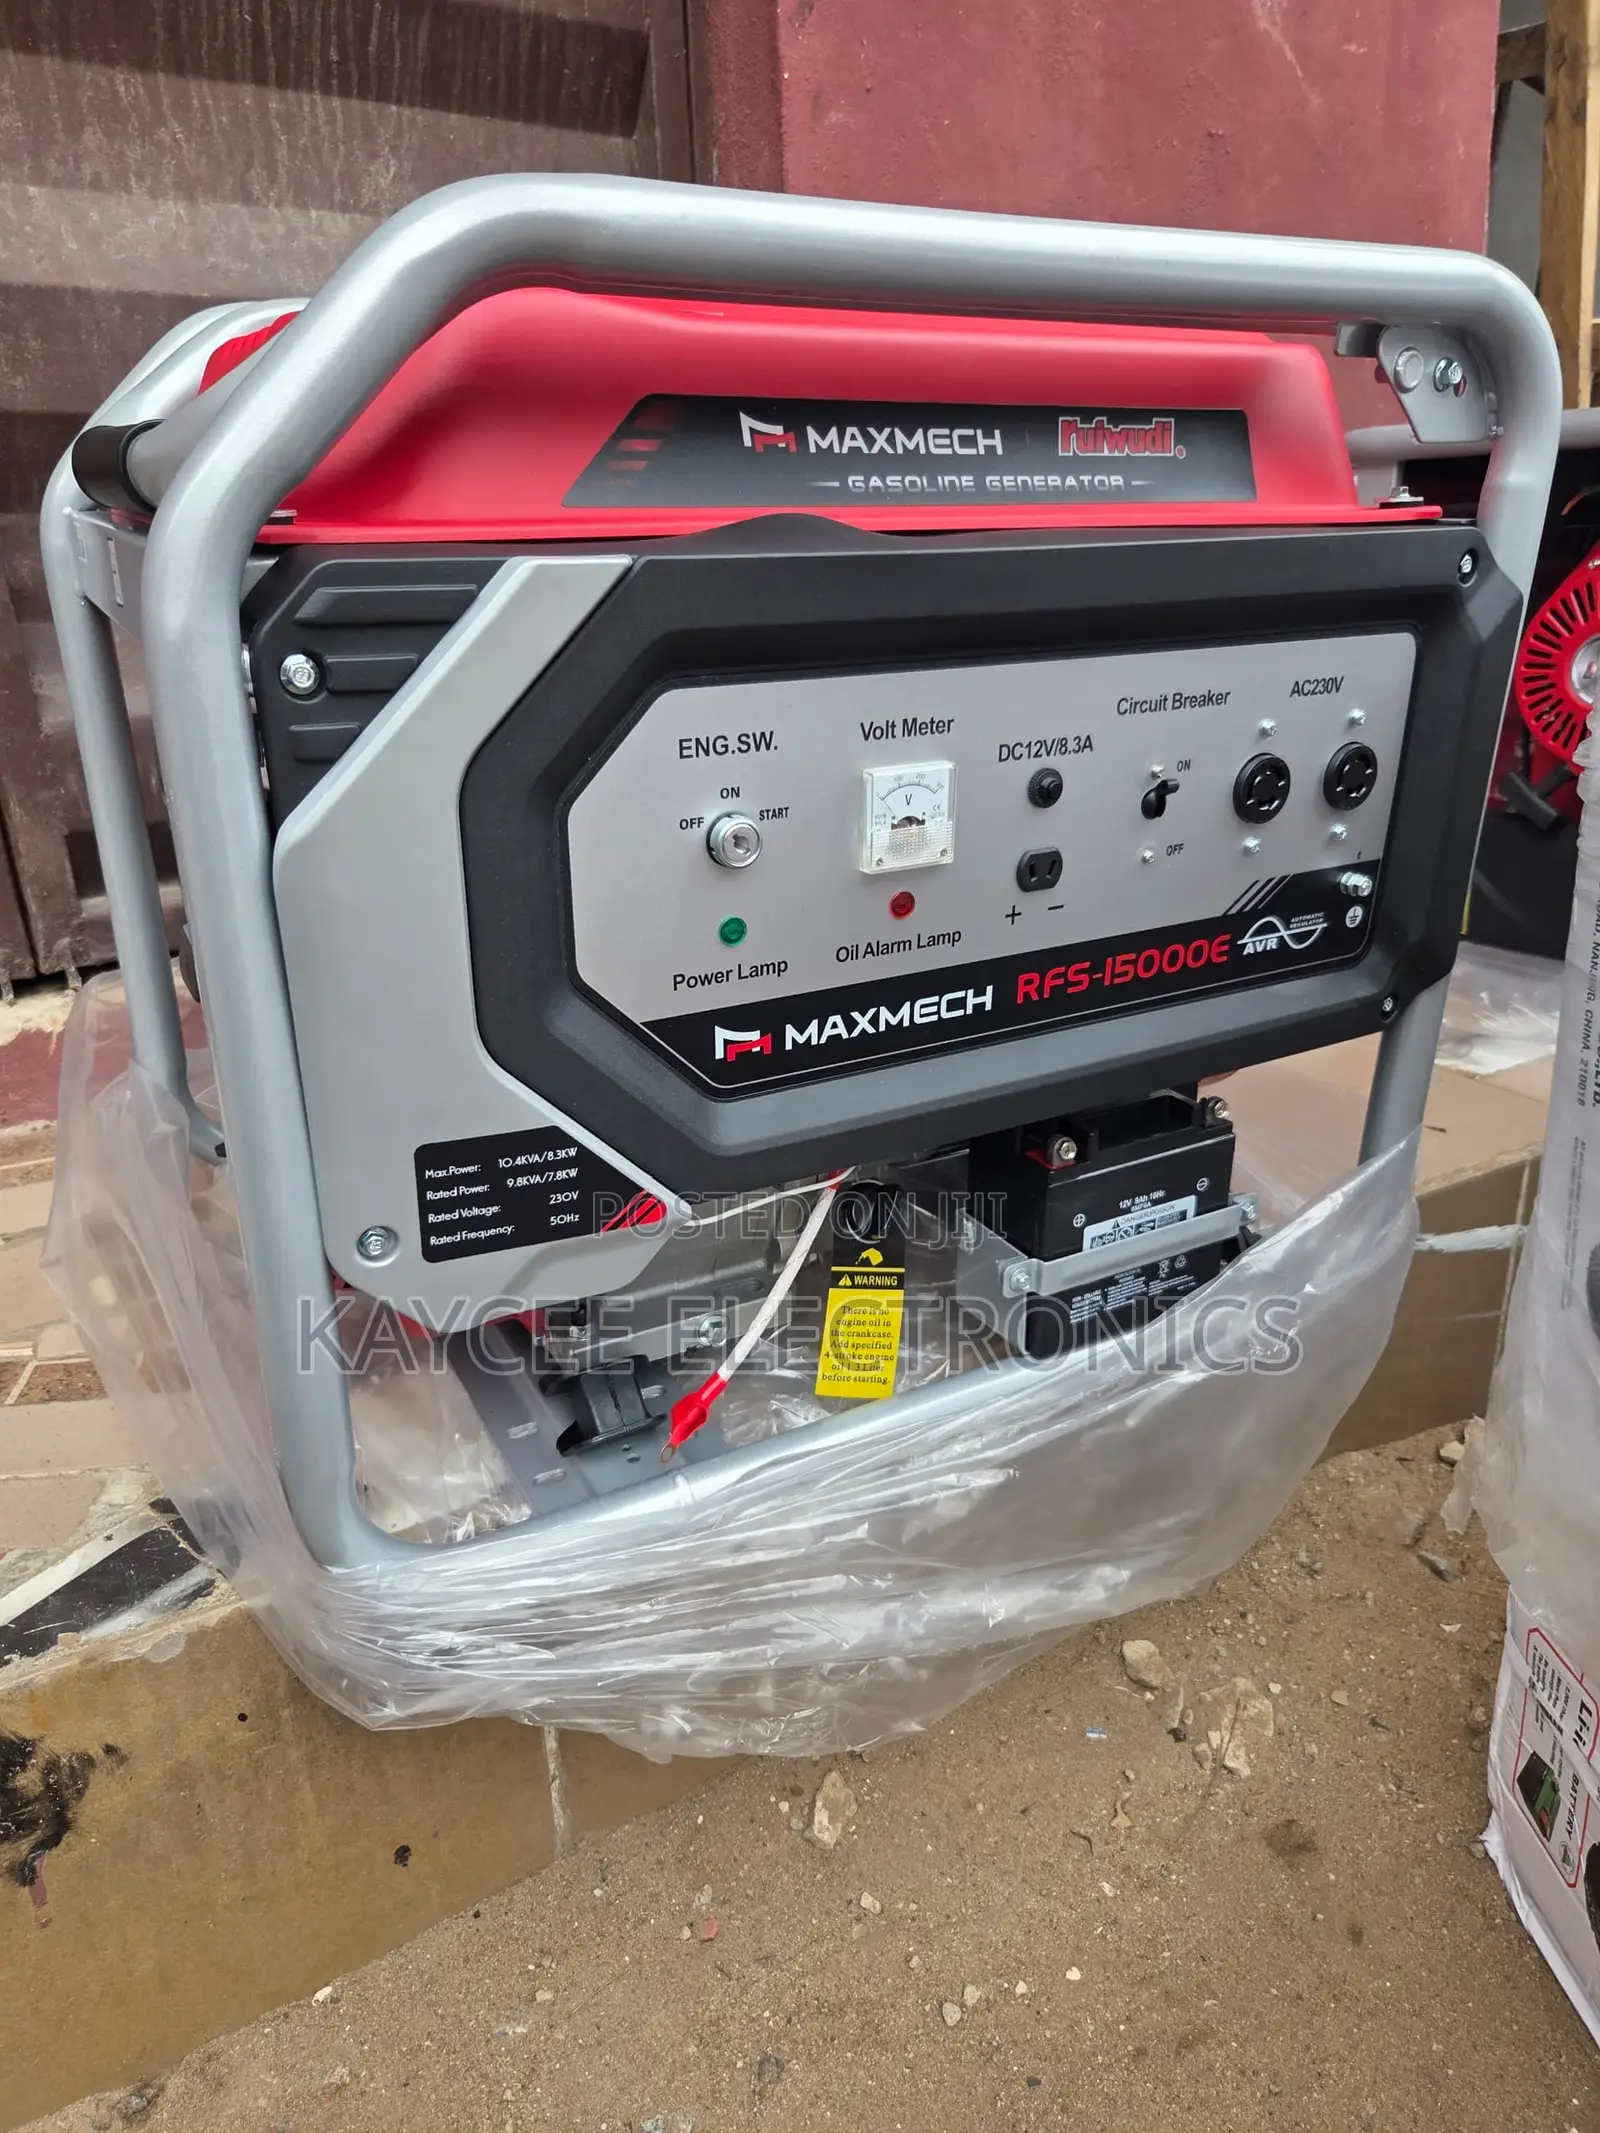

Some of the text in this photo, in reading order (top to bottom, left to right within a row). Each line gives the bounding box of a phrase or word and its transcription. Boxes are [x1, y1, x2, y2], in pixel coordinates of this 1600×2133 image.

[806, 425, 1003, 455] MAXMECH
[847, 475, 1126, 493] GASOLINE GENERATOR
[1289, 675, 1345, 698] AC230V
[1116, 688, 1231, 717] Circuit Breaker
[859, 715, 955, 742] Volt Meter
[678, 731, 779, 760] ENG.SW.
[998, 734, 1094, 763] DC12V/8.3A
[1176, 759, 1191, 772] ON
[720, 786, 741, 800] ON
[905, 793, 913, 806] V
[758, 807, 790, 822] START
[679, 816, 705, 831] OFF
[1165, 843, 1184, 857] OFF
[1290, 911, 1326, 923] AUTOMATIC
[835, 928, 962, 963] Oil Alarm Lamp
[1242, 938, 1279, 955] AVR
[672, 957, 789, 991] Power Lamp
[785, 933, 1232, 1051] MAXMECH RFS-15000E
[425, 1147, 578, 1180] Max.Power: 10.4KVA/8.3KW
[426, 1168, 579, 1201] Rated Power: 9.8KVA/7.8KW
[428, 1191, 580, 1224] Rated Voltage: 230V
[430, 1213, 580, 1246] Rated Frequency: 50Hz
[854, 1274, 899, 1286] WARNING
[842, 1306, 867, 1315] There
[869, 1307, 877, 1315] is
[836, 1318, 892, 1328] engine oil in
[831, 1328, 845, 1337] the
[830, 1339, 892, 1351] Add specified
[831, 1362, 844, 1370] oil
[864, 1353, 894, 1363] engine
[822, 1374, 890, 1385] before starting.
[1565, 1772, 1580, 1841] BATTERY
